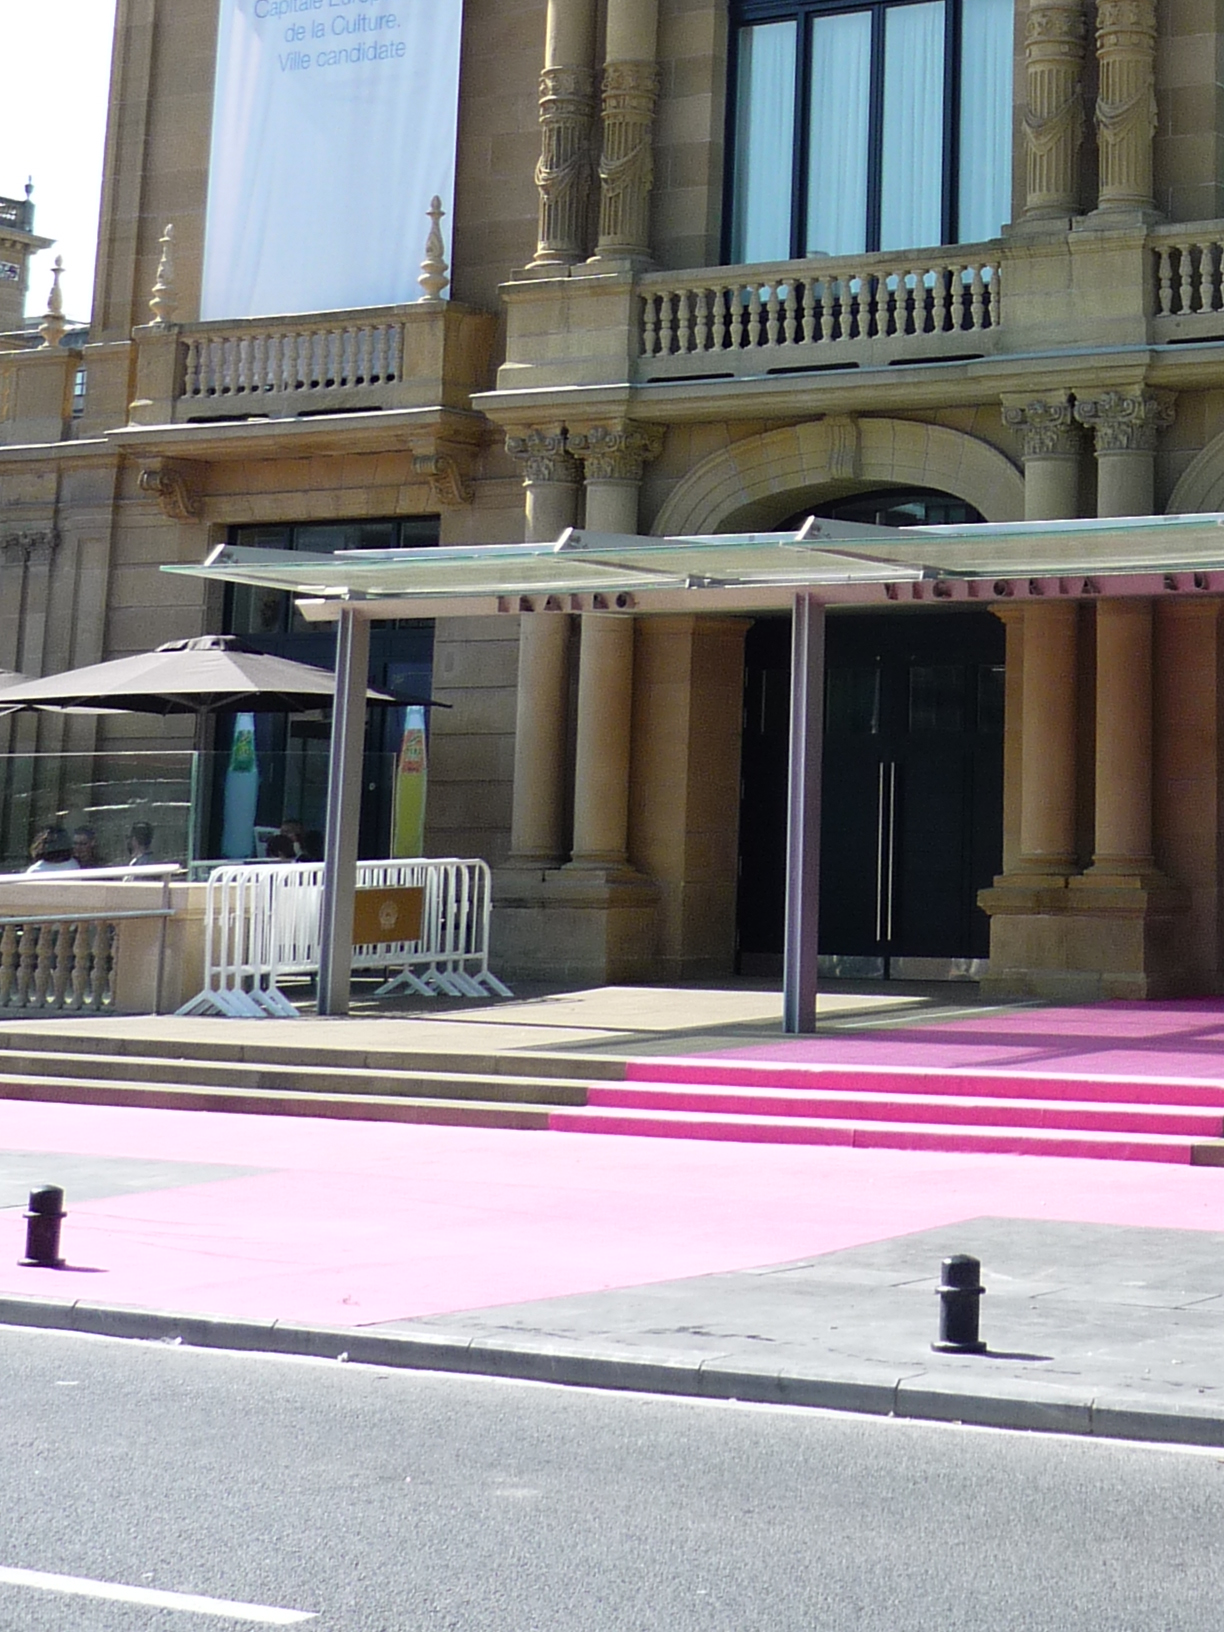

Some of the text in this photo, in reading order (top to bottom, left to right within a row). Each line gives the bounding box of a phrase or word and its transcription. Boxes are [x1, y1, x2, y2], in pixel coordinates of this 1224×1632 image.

[284, 13, 401, 43] de la Culture.
[278, 40, 407, 72] Ville candidate
[883, 575, 1101, 601] VICTORIA
